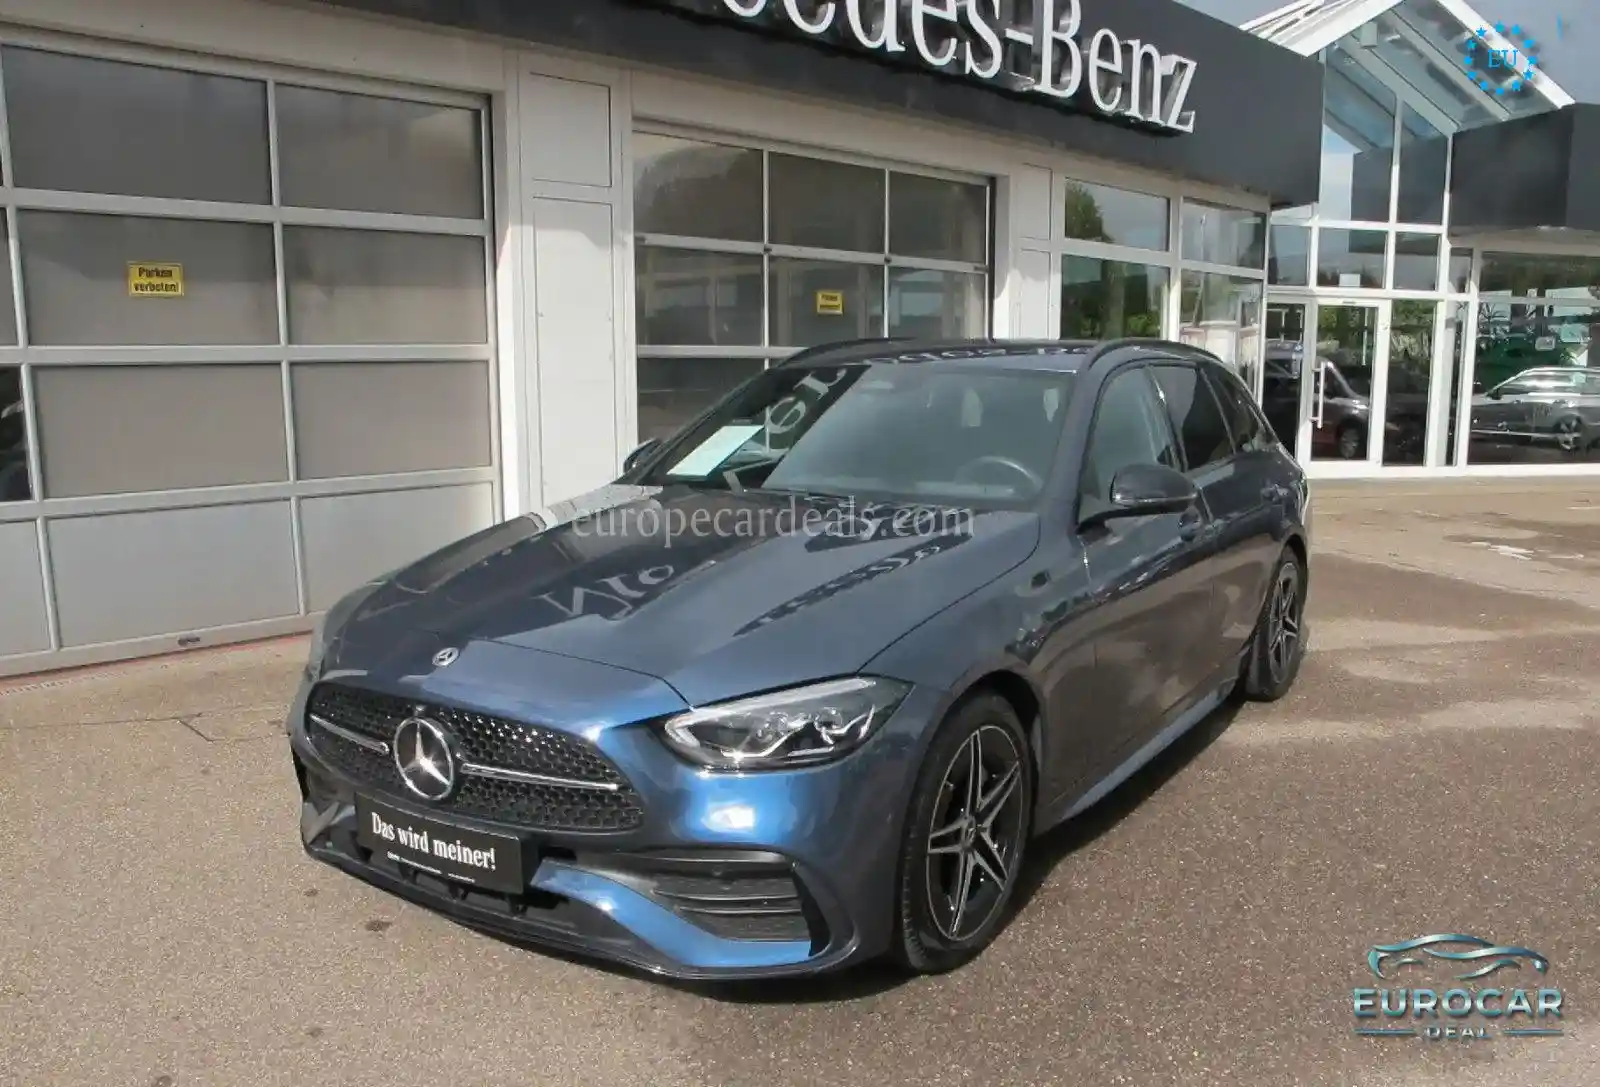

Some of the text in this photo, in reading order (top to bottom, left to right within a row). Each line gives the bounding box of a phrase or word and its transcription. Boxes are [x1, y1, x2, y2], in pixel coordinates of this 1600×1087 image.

[722, 0, 1197, 133] es-Benz
[371, 811, 396, 842] Das
[397, 825, 430, 854] wird
[432, 839, 497, 871] meiner!
